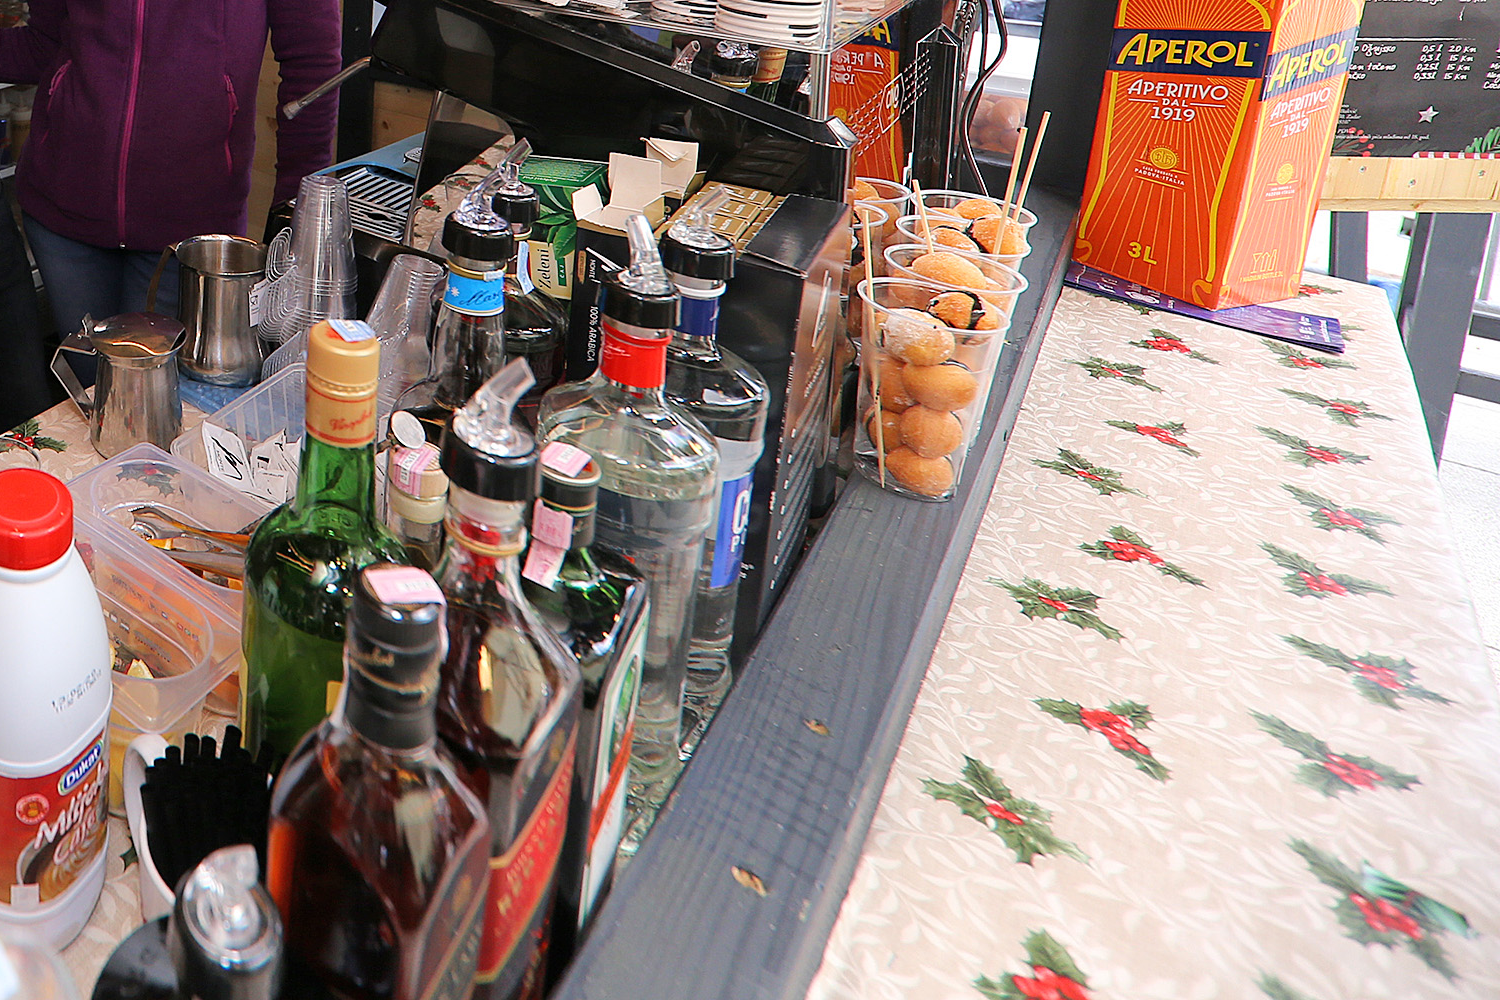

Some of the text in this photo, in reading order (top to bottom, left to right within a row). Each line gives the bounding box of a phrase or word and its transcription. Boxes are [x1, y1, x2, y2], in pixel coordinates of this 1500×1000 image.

[1116, 33, 1254, 68] APEROL
[1448, 45, 1462, 53] 20
[1463, 45, 1477, 53] Kn
[1266, 39, 1347, 92] APEROL
[1127, 79, 1229, 101] APERITIVO
[1162, 98, 1189, 108] DAL
[1270, 87, 1331, 121] APERITIVO
[1151, 106, 1196, 122] 1919
[1282, 118, 1309, 138] 1919
[1289, 110, 1306, 122] DAL
[539, 248, 552, 290] Zeleni
[586, 306, 599, 362] 100% ARABICA
[65, 747, 100, 788] Dukat
